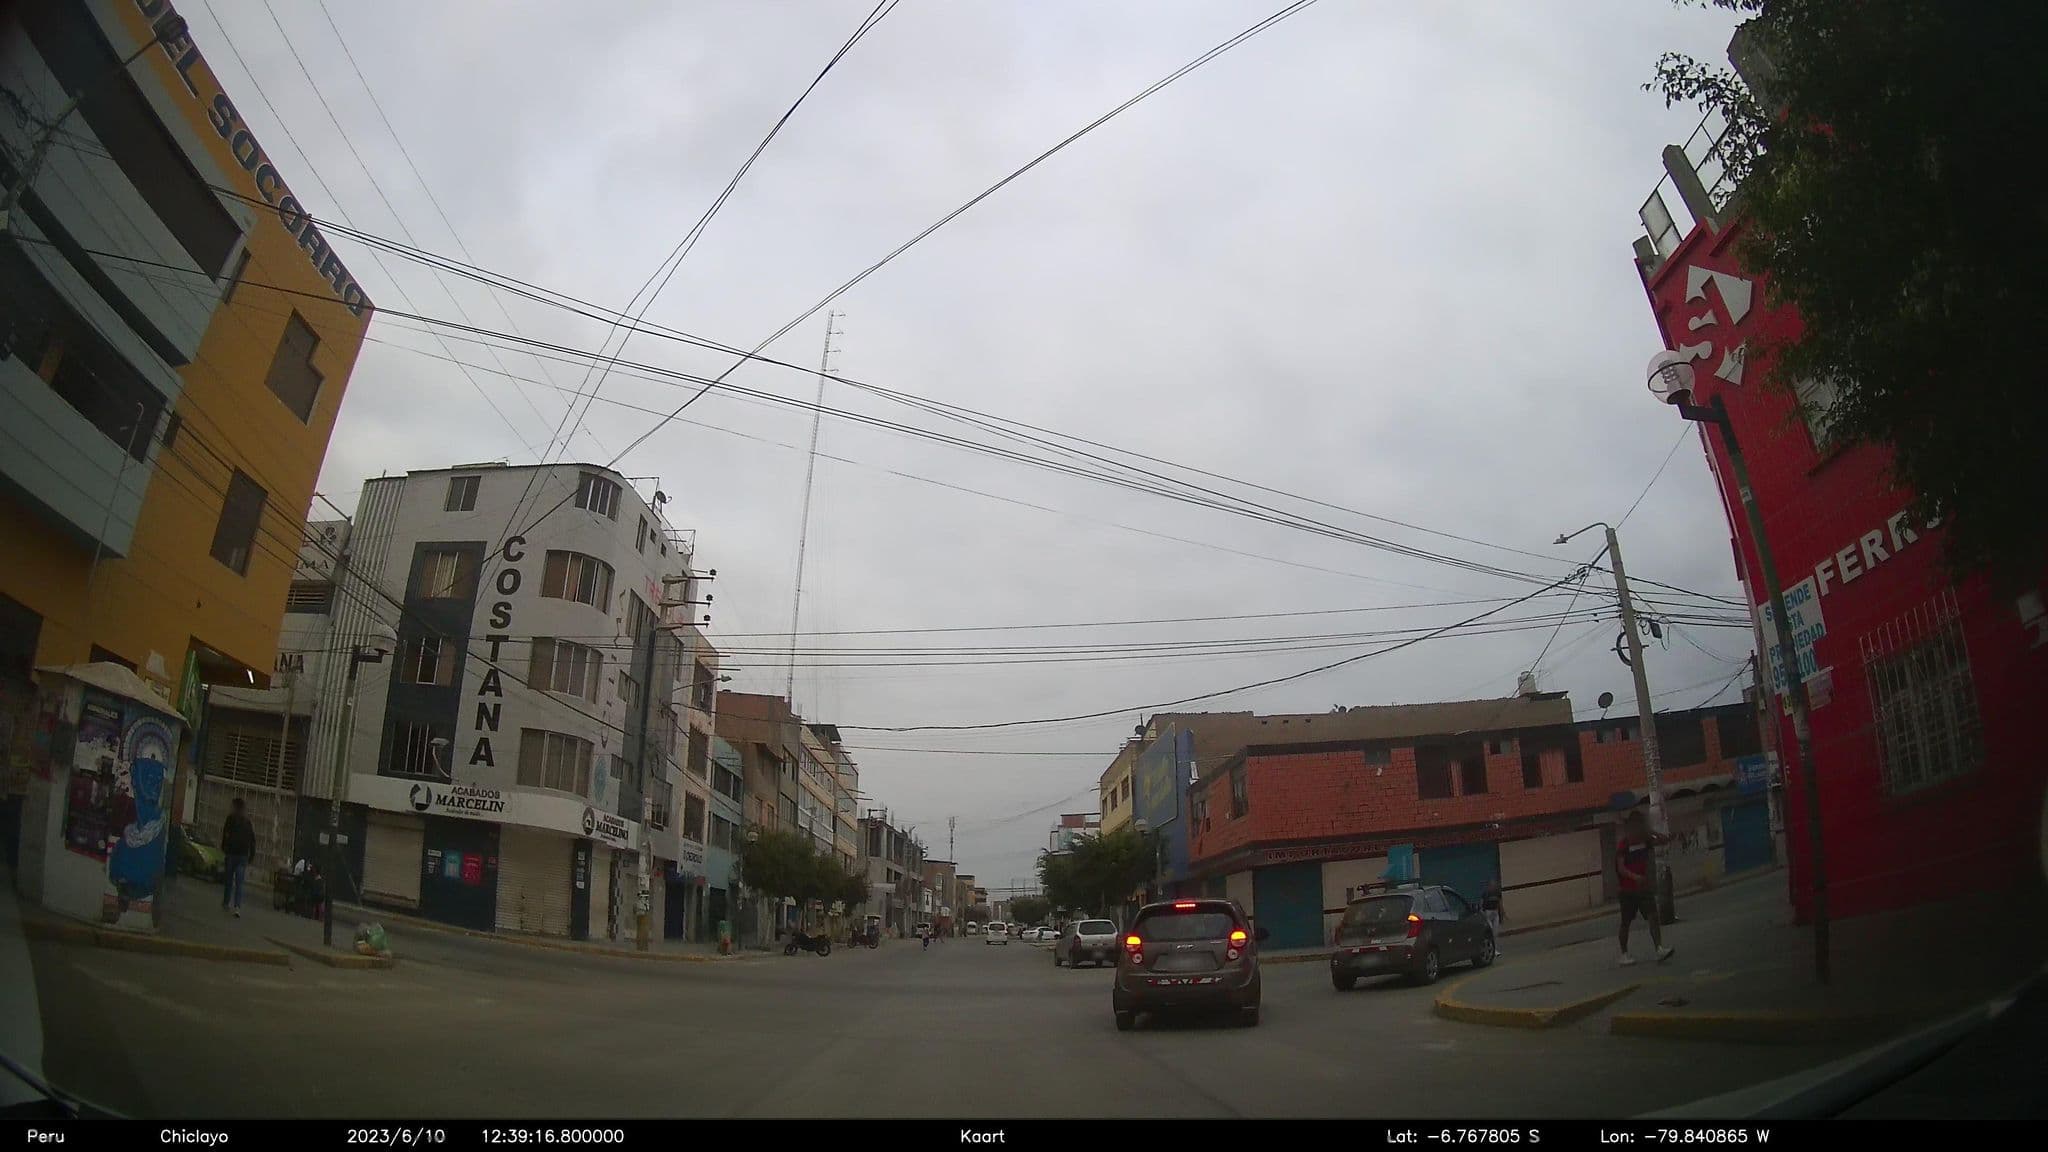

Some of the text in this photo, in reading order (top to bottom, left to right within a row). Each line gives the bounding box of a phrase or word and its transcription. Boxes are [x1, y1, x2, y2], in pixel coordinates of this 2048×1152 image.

[207, 92, 368, 318] SOCORRO
[1784, 583, 1812, 612] ENDE
[468, 535, 527, 767] COSTANA
[435, 794, 505, 812] MARCELIN
[451, 787, 501, 799] ACABADOS
